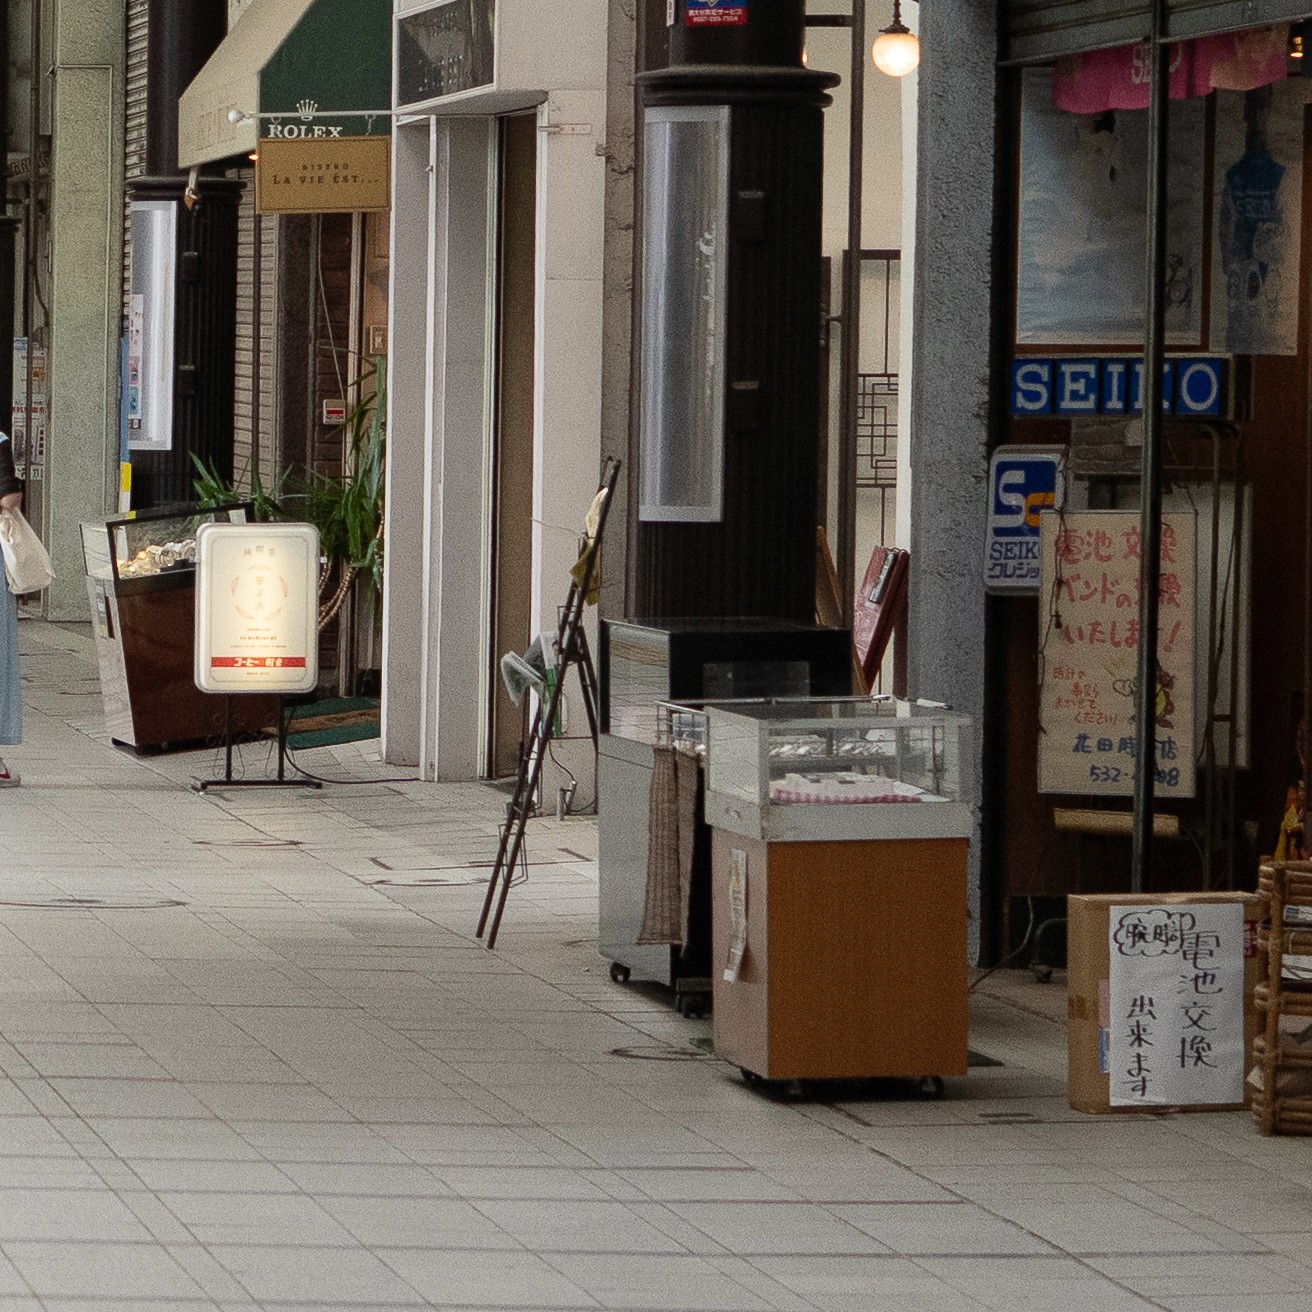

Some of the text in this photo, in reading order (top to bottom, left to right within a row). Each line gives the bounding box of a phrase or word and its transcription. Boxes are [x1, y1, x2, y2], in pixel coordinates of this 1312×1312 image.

[267, 123, 344, 139] ROLEX
[301, 163, 350, 171] BISTRO
[272, 175, 292, 185] LA
[299, 174, 325, 184] VIE
[989, 541, 1040, 561] SEIK
[987, 562, 1041, 580] クレジッ
[1055, 571, 1182, 609] バンドの換
[1071, 733, 1177, 761] 花田時店
[1176, 929, 1224, 1070] 電池交換
[1121, 994, 1159, 1097] 出来ます
